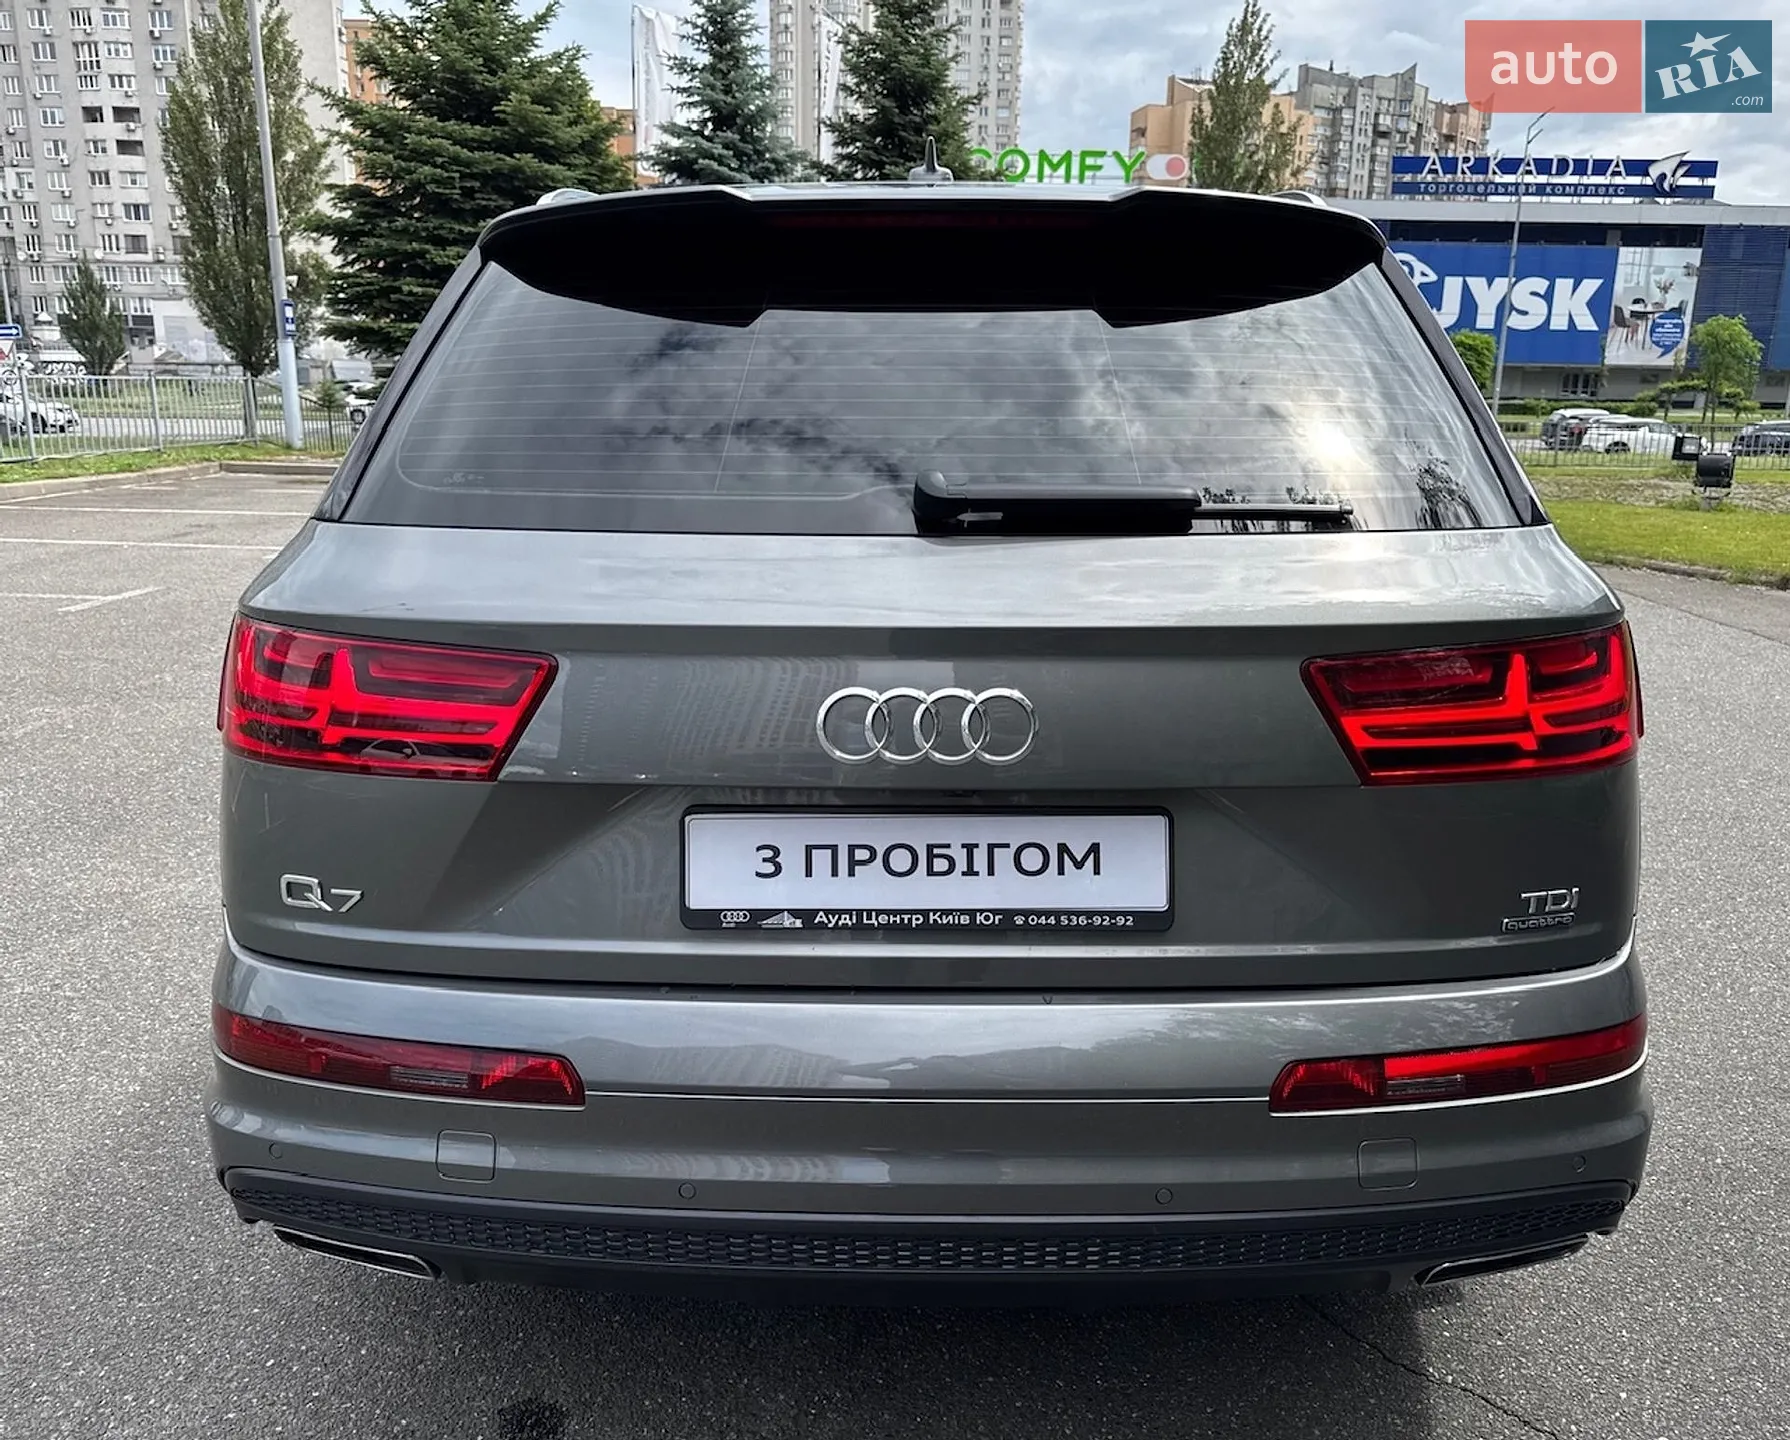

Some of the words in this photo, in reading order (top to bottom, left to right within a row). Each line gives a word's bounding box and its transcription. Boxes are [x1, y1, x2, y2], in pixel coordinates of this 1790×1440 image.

[1421, 150, 1627, 180] ARKADIA
[1434, 275, 1604, 331] JYSK
[804, 842, 1102, 879] ПРОБІГОМ
[280, 873, 363, 912] Q7
[814, 911, 856, 928] Ауді
[862, 911, 924, 928] Центр
[929, 910, 970, 925] Київ
[976, 911, 1003, 925] Юг
[1028, 915, 1056, 926] 044
[1060, 915, 1134, 926] 536-92-92
[1507, 915, 1573, 931] quattro
